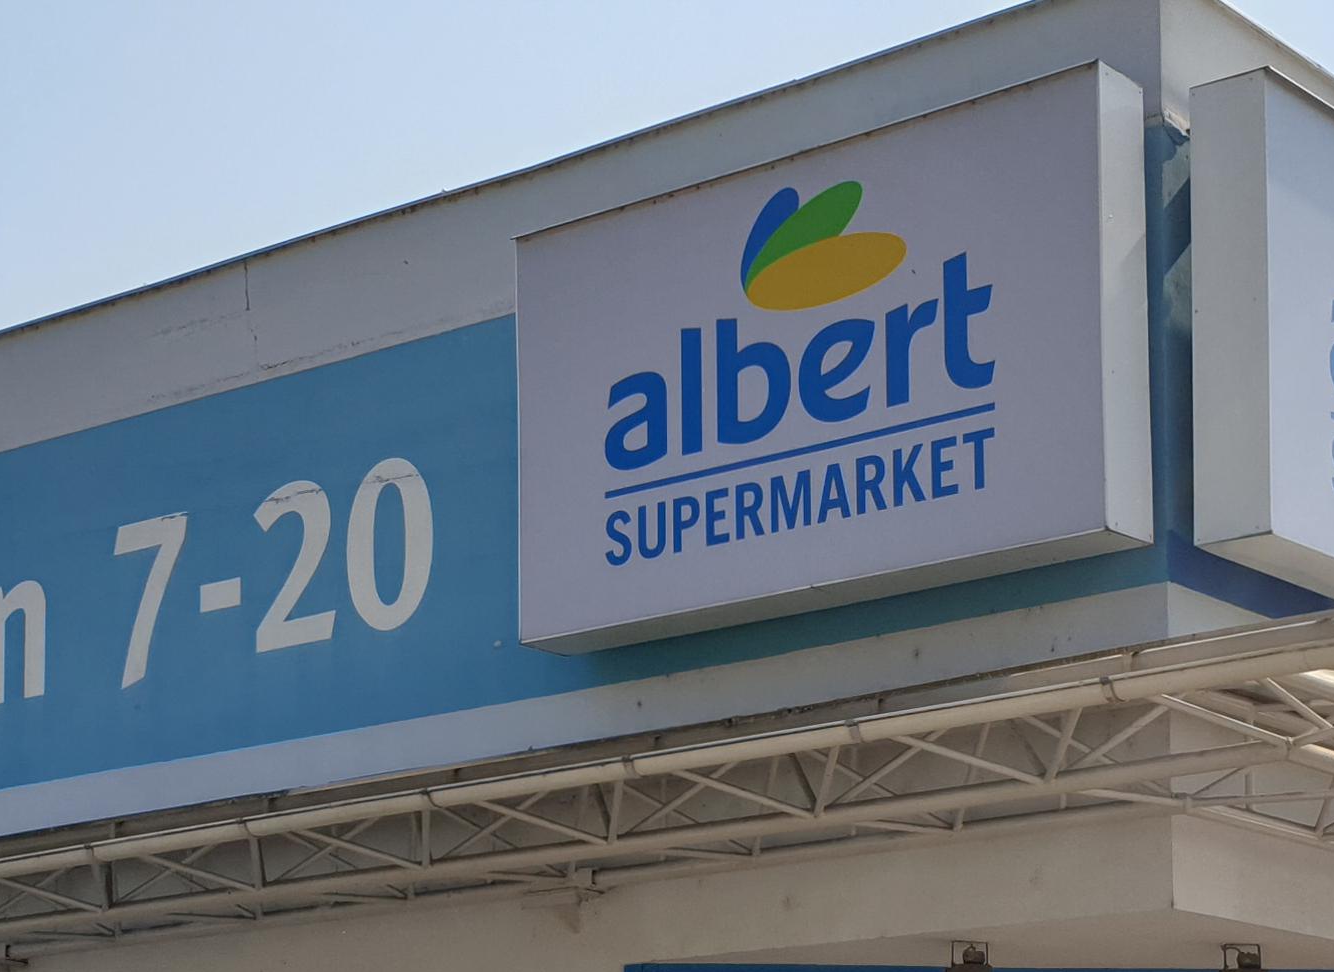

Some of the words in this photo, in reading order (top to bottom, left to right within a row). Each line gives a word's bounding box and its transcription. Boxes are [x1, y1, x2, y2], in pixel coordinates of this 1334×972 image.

[604, 251, 996, 471] albert
[113, 457, 434, 689] 7-20
[605, 427, 995, 567] SUPERMARKET
